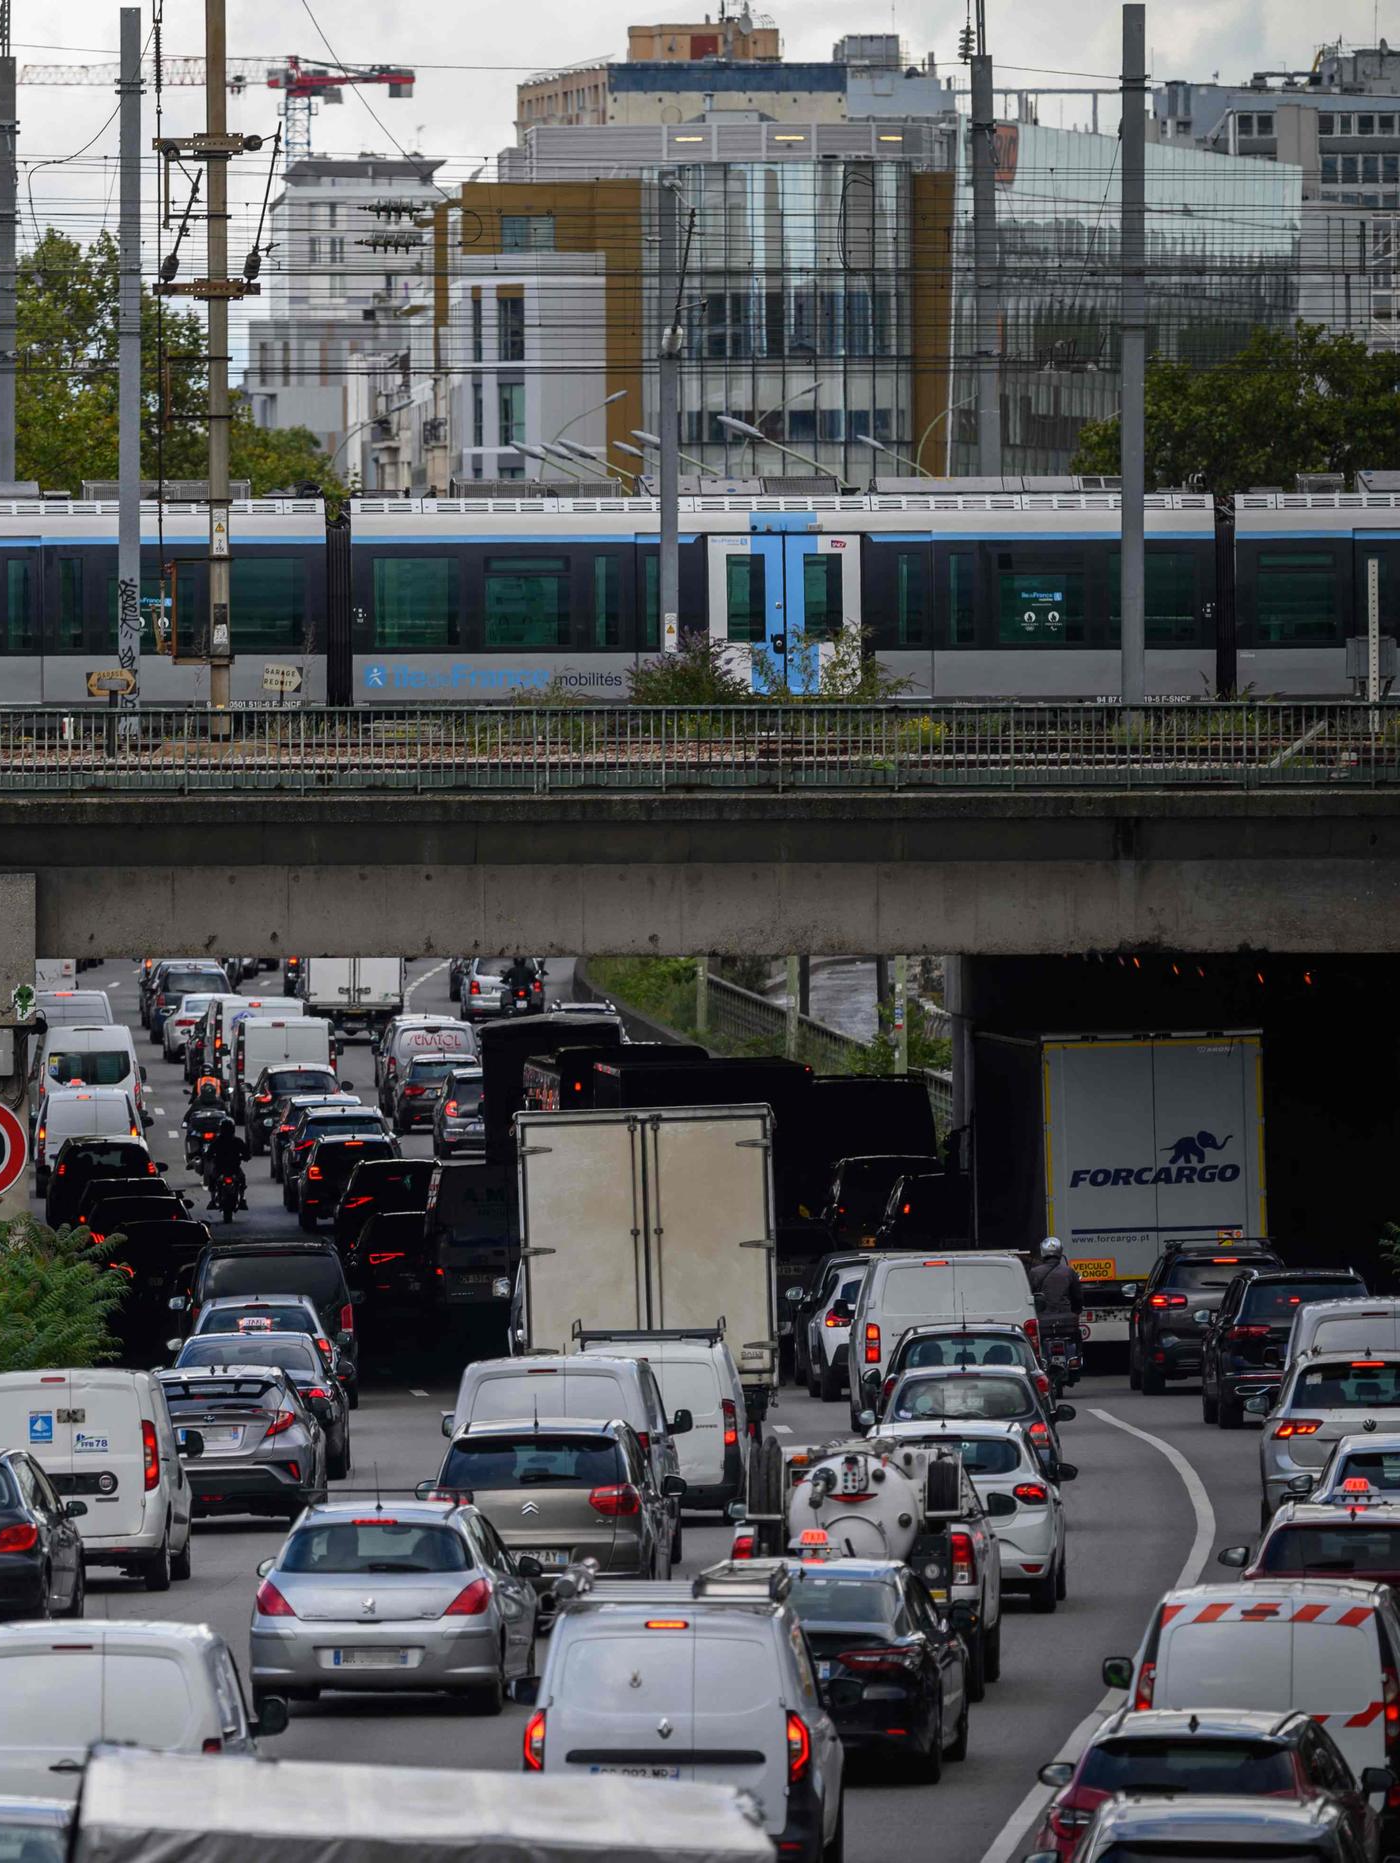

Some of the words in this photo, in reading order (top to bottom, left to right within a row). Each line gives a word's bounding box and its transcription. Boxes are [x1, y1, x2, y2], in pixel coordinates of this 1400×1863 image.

[264, 667, 297, 678] GARAGE
[554, 672, 622, 687] mobilités
[1070, 1164, 1240, 1188] FORCARGO
[1071, 1234, 1150, 1246] www.forcargo.pt
[1073, 1262, 1112, 1272] VEICULO
[1080, 1269, 1109, 1278] ONGO
[95, 1439, 108, 1448] 78
